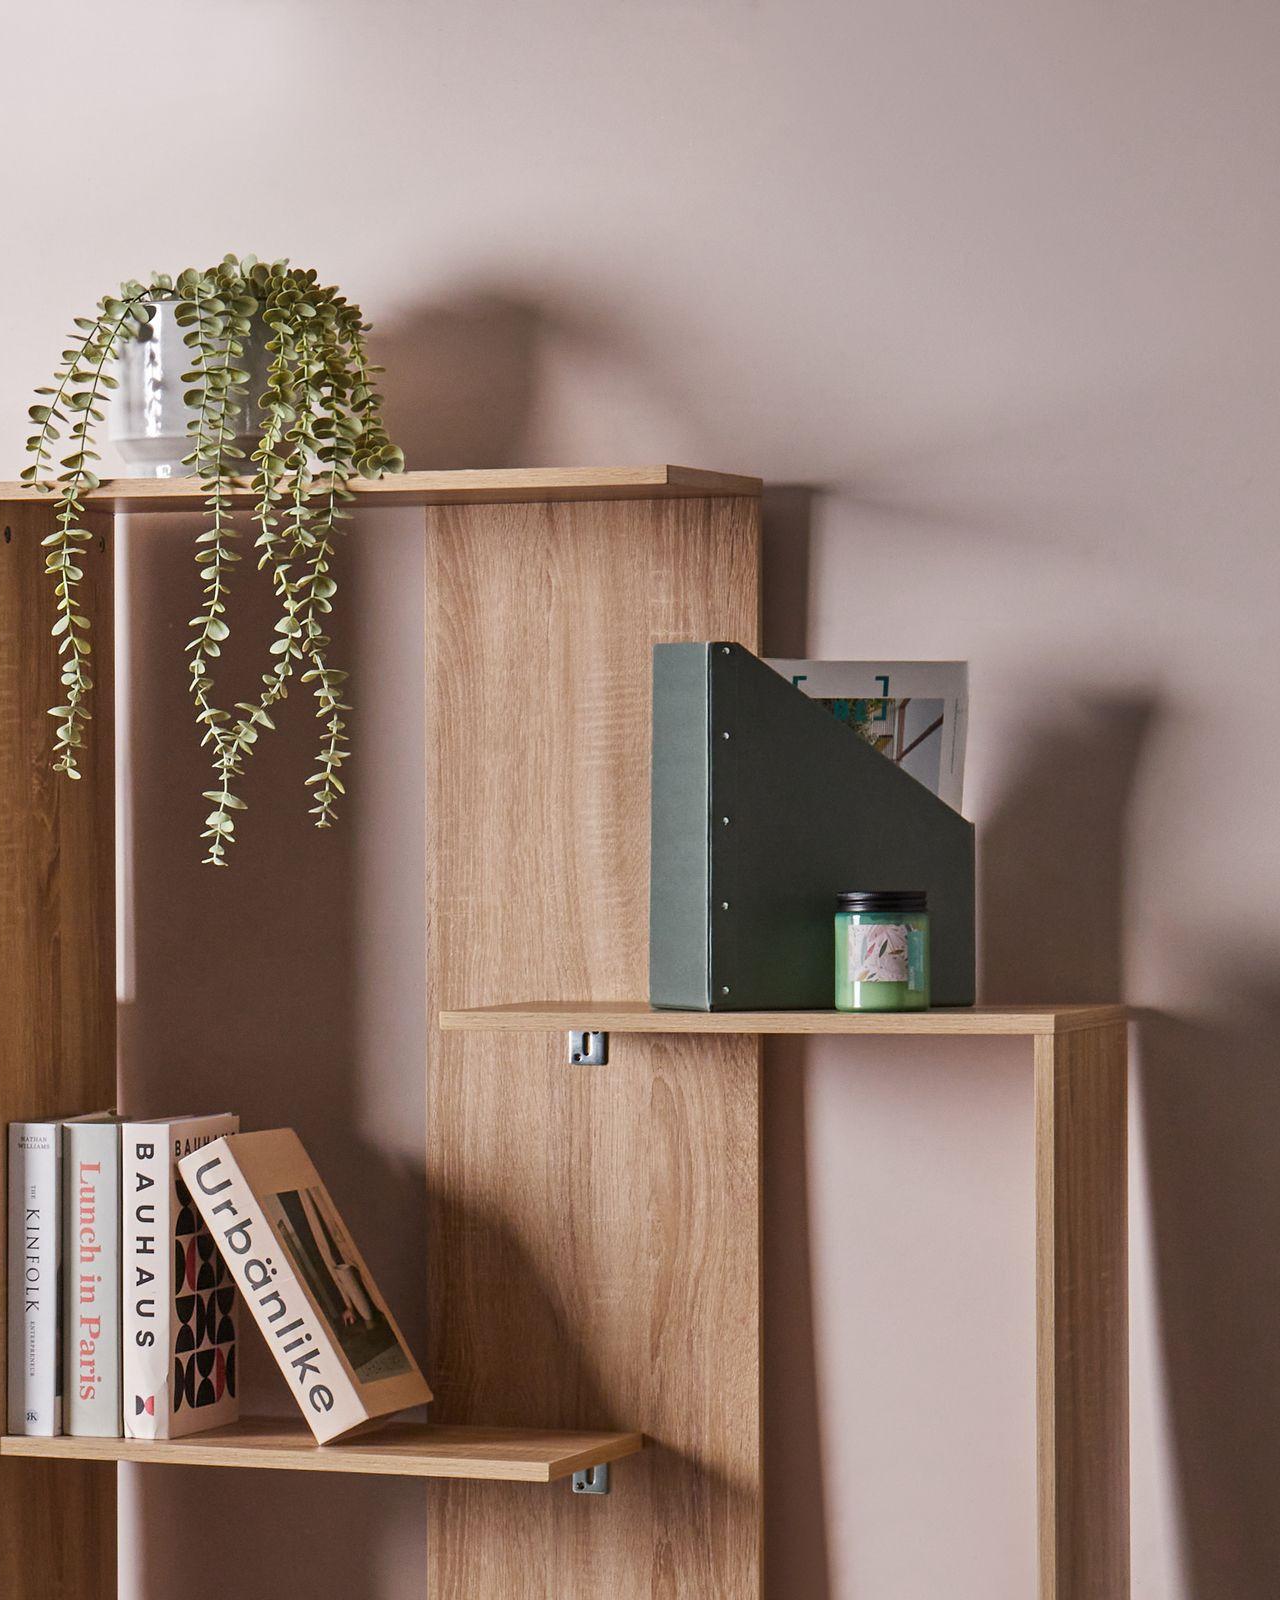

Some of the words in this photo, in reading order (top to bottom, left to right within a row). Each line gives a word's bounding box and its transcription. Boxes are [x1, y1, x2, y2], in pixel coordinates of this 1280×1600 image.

[26, 1208, 40, 1313] KINFOLK
[79, 1161, 101, 1263] Lunch
[135, 1143, 155, 1347] BAUHAUS
[79, 1274, 102, 1303] in
[195, 1157, 335, 1413] Urbänlike
[79, 1315, 102, 1401] Paris
